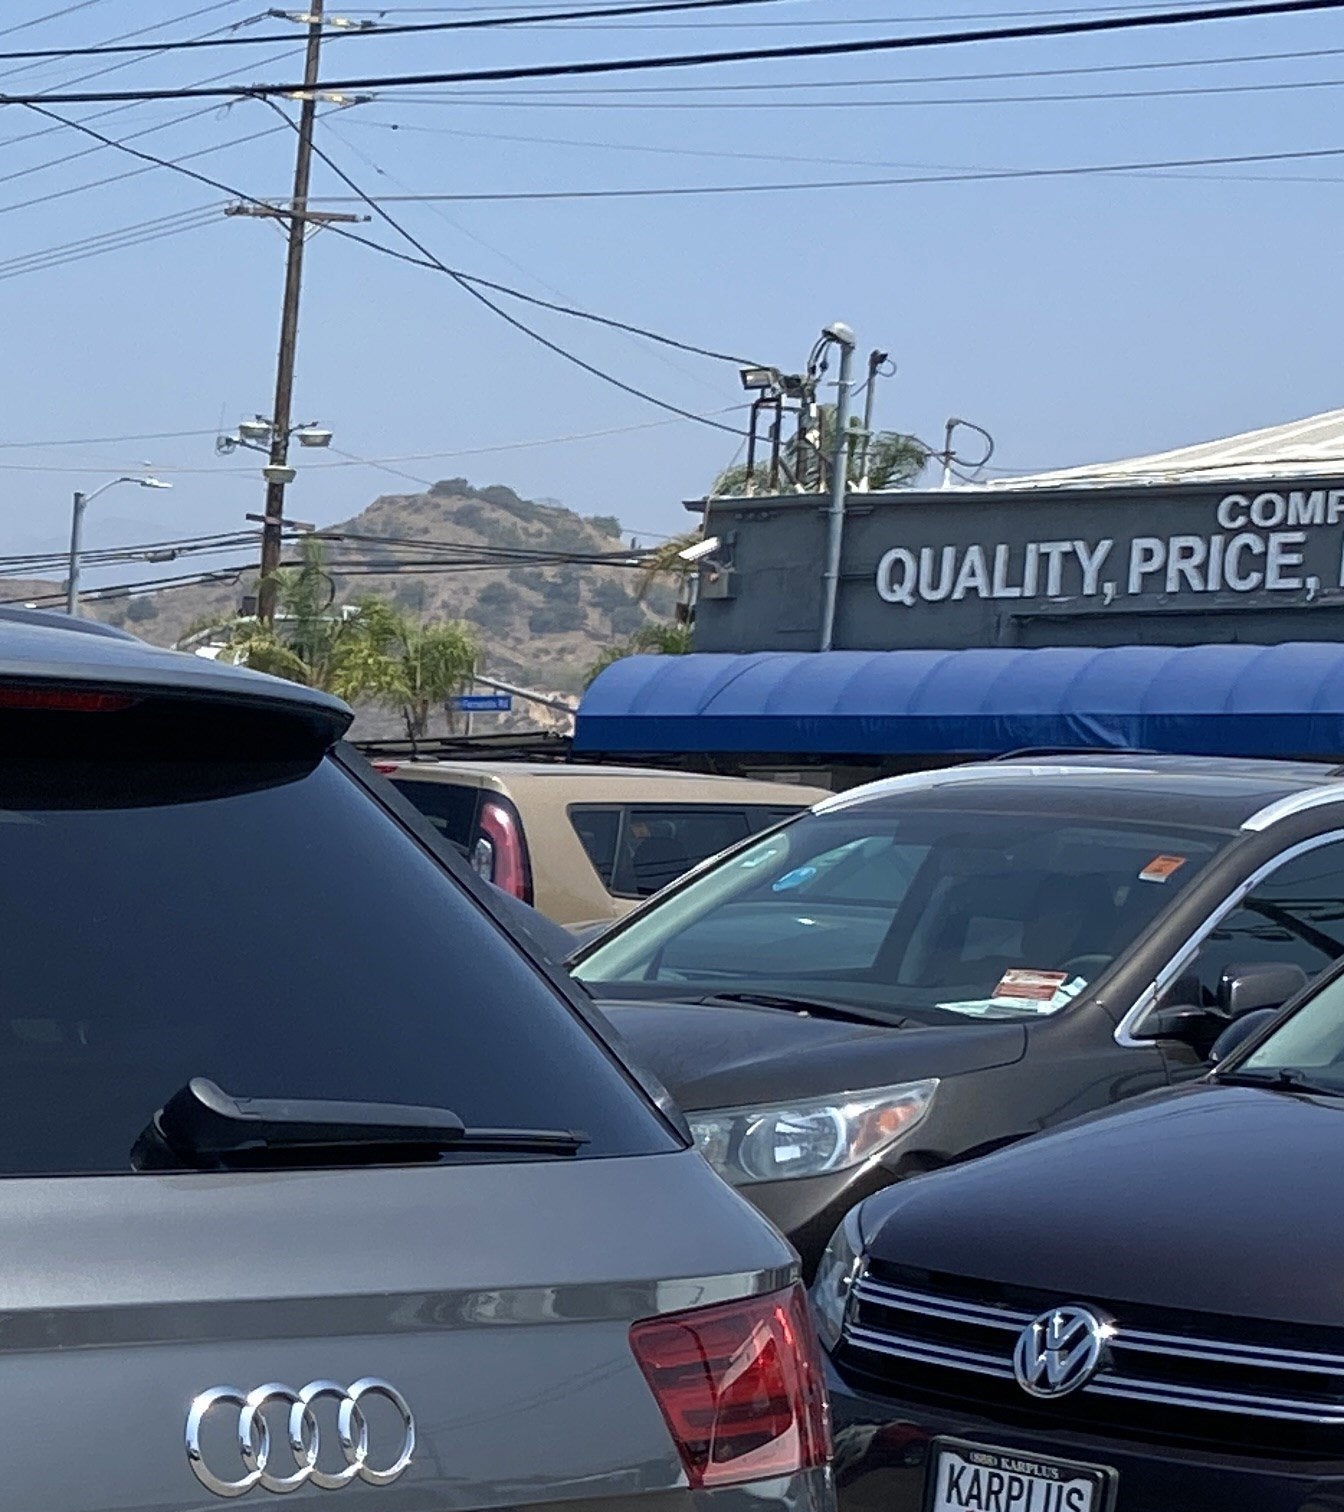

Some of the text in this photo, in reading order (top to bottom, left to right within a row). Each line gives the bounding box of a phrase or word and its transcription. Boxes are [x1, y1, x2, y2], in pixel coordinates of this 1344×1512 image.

[876, 538, 1118, 607] QUALITY,
[1127, 531, 1321, 601] PRICE,
[1000, 1456, 1060, 1480] KARPLUS
